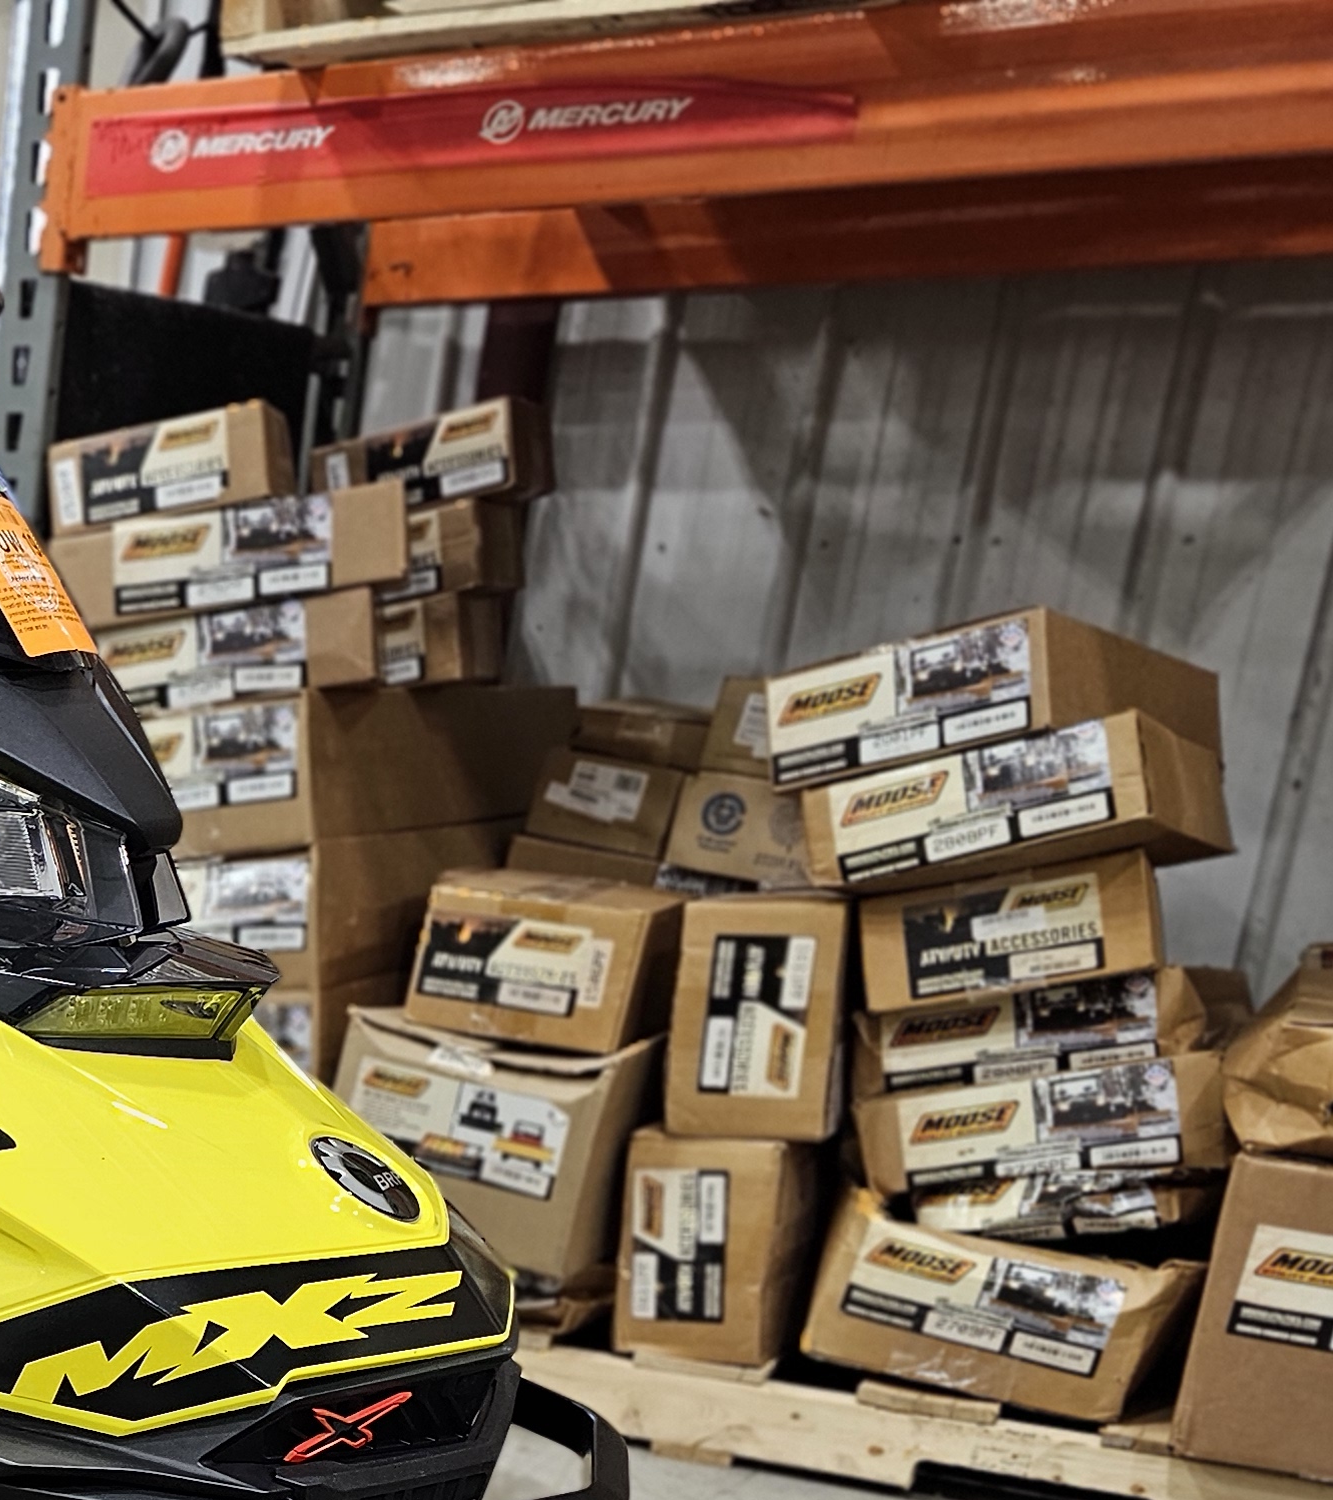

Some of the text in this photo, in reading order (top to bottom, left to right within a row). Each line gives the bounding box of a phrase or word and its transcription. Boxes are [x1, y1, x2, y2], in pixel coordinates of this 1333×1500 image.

[527, 97, 694, 131] MERCURY
[192, 125, 336, 159] MERCURY
[792, 681, 871, 712] MOOSE
[851, 778, 939, 815] MOOSE
[1018, 886, 1081, 907] MOOSE
[989, 922, 1099, 953] ACCESSORIES
[921, 1105, 1009, 1134] MOOSE
[881, 1241, 963, 1276] MOOSE
[10, 1269, 464, 1405] MXZ
